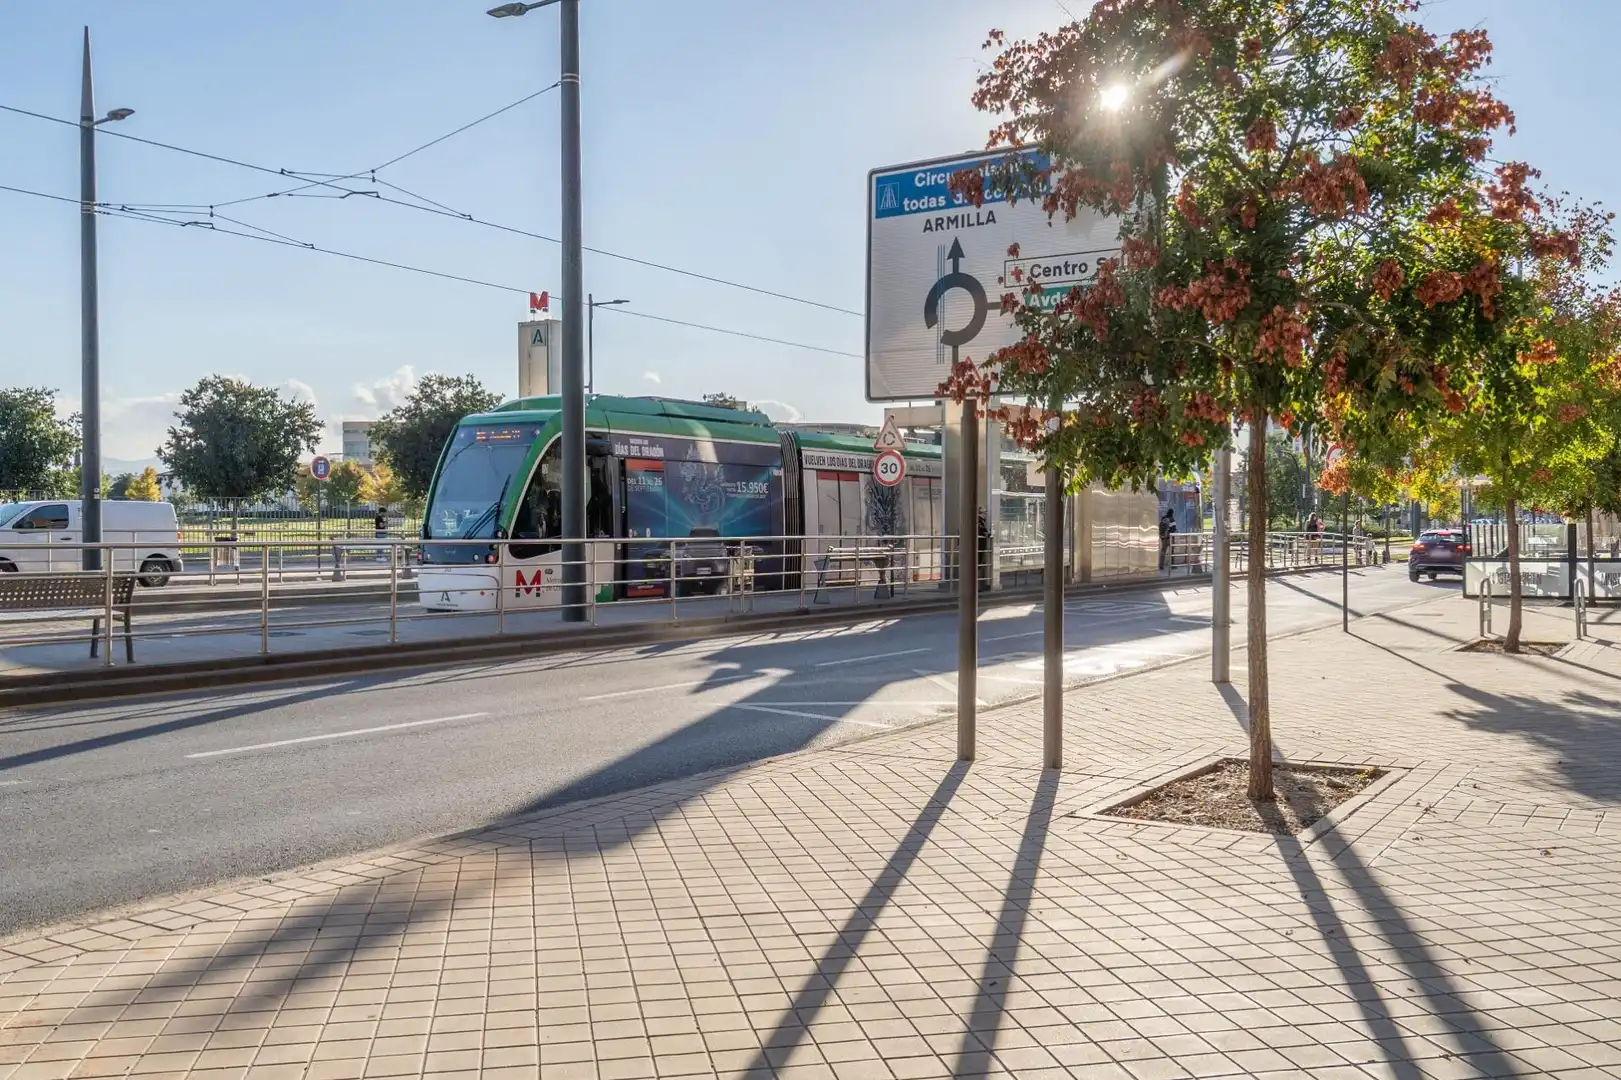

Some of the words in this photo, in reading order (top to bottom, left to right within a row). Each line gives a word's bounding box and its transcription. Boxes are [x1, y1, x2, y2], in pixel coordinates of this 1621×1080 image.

[903, 195, 946, 212] todas
[923, 210, 997, 233] ARMILLA
[1030, 260, 1088, 279] Centro
[804, 453, 826, 466] VUELVEN
[827, 456, 837, 467] LOS
[881, 462, 898, 474] 30
[638, 476, 646, 485] 11
[655, 476, 663, 486] 26
